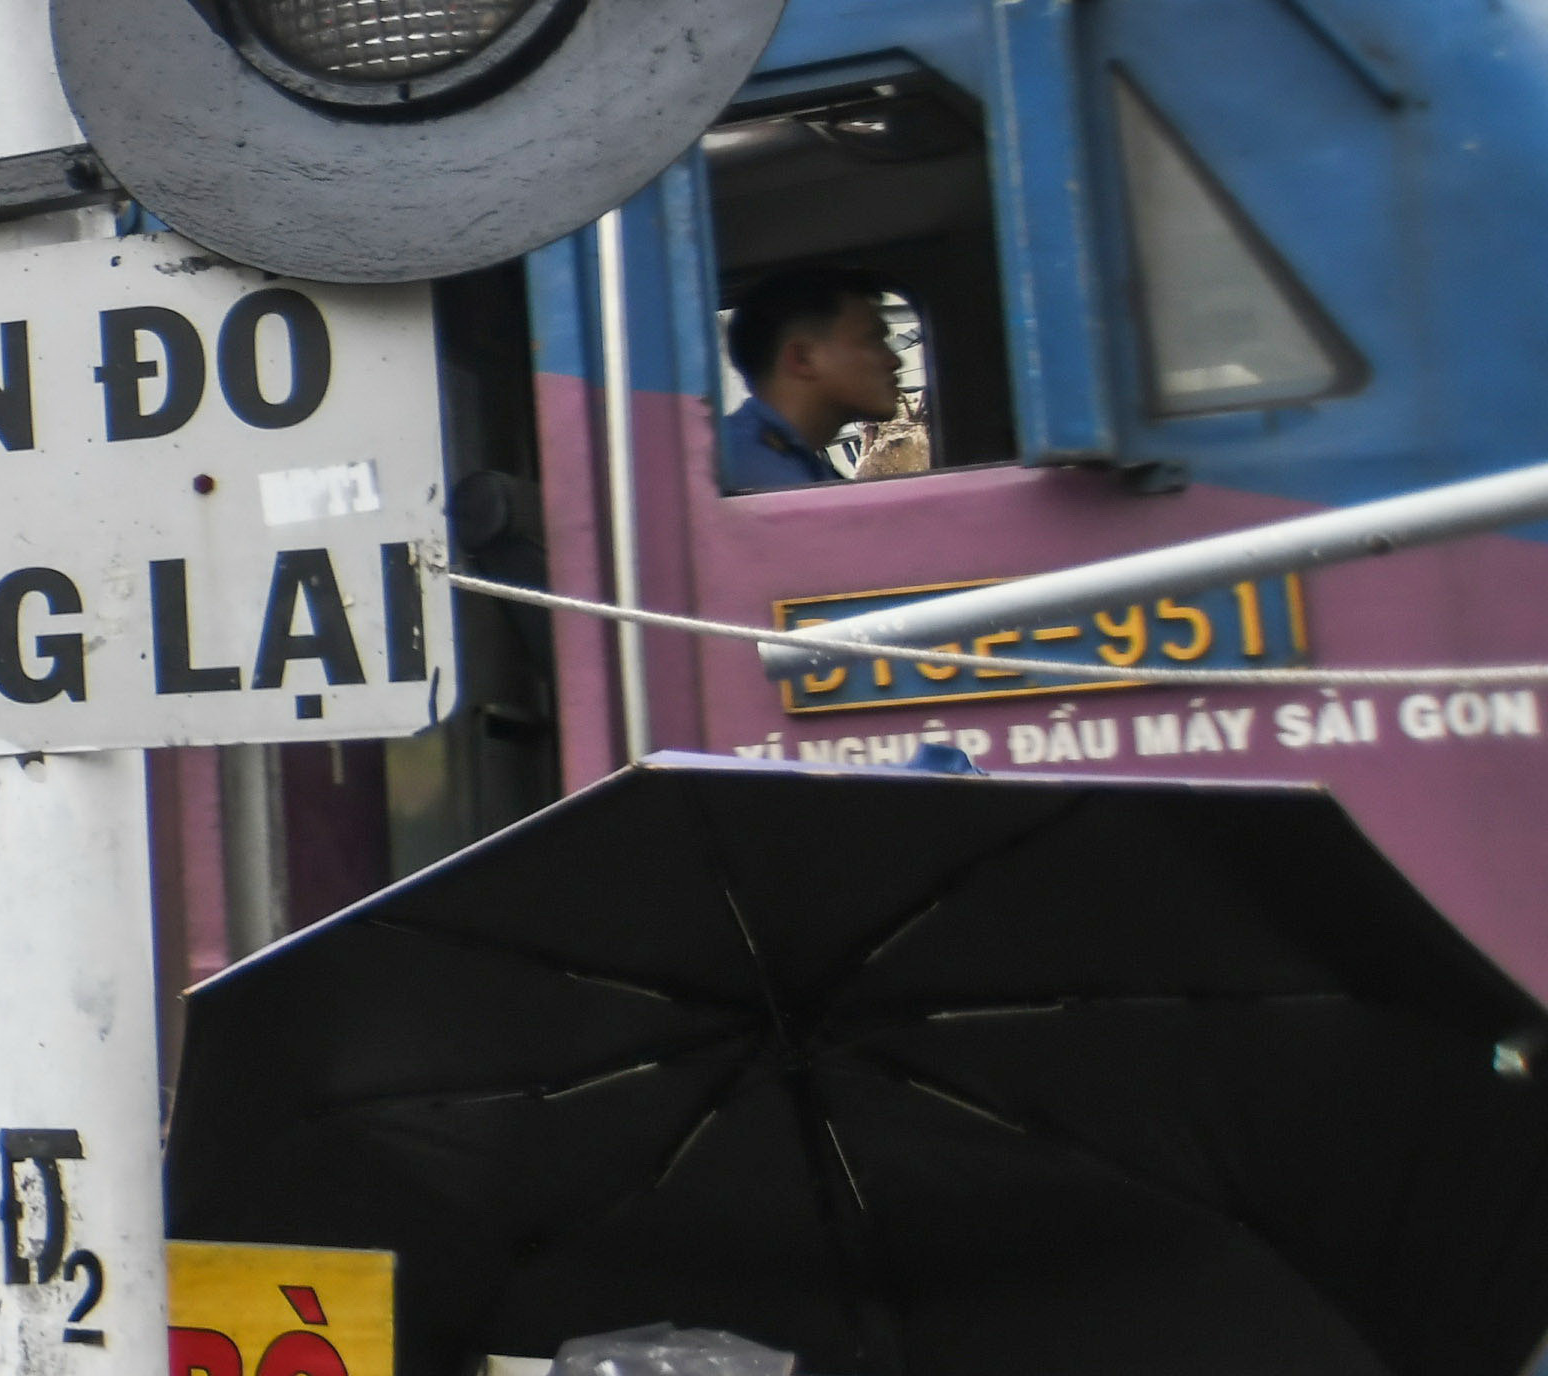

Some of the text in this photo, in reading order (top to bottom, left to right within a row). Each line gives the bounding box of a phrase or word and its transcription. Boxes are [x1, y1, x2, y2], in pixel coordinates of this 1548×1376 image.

[147, 541, 428, 720] LẠI
[1008, 702, 1120, 765] ĐẦU
[1132, 698, 1255, 757] MÁY
[1273, 687, 1378, 748] SÀI
